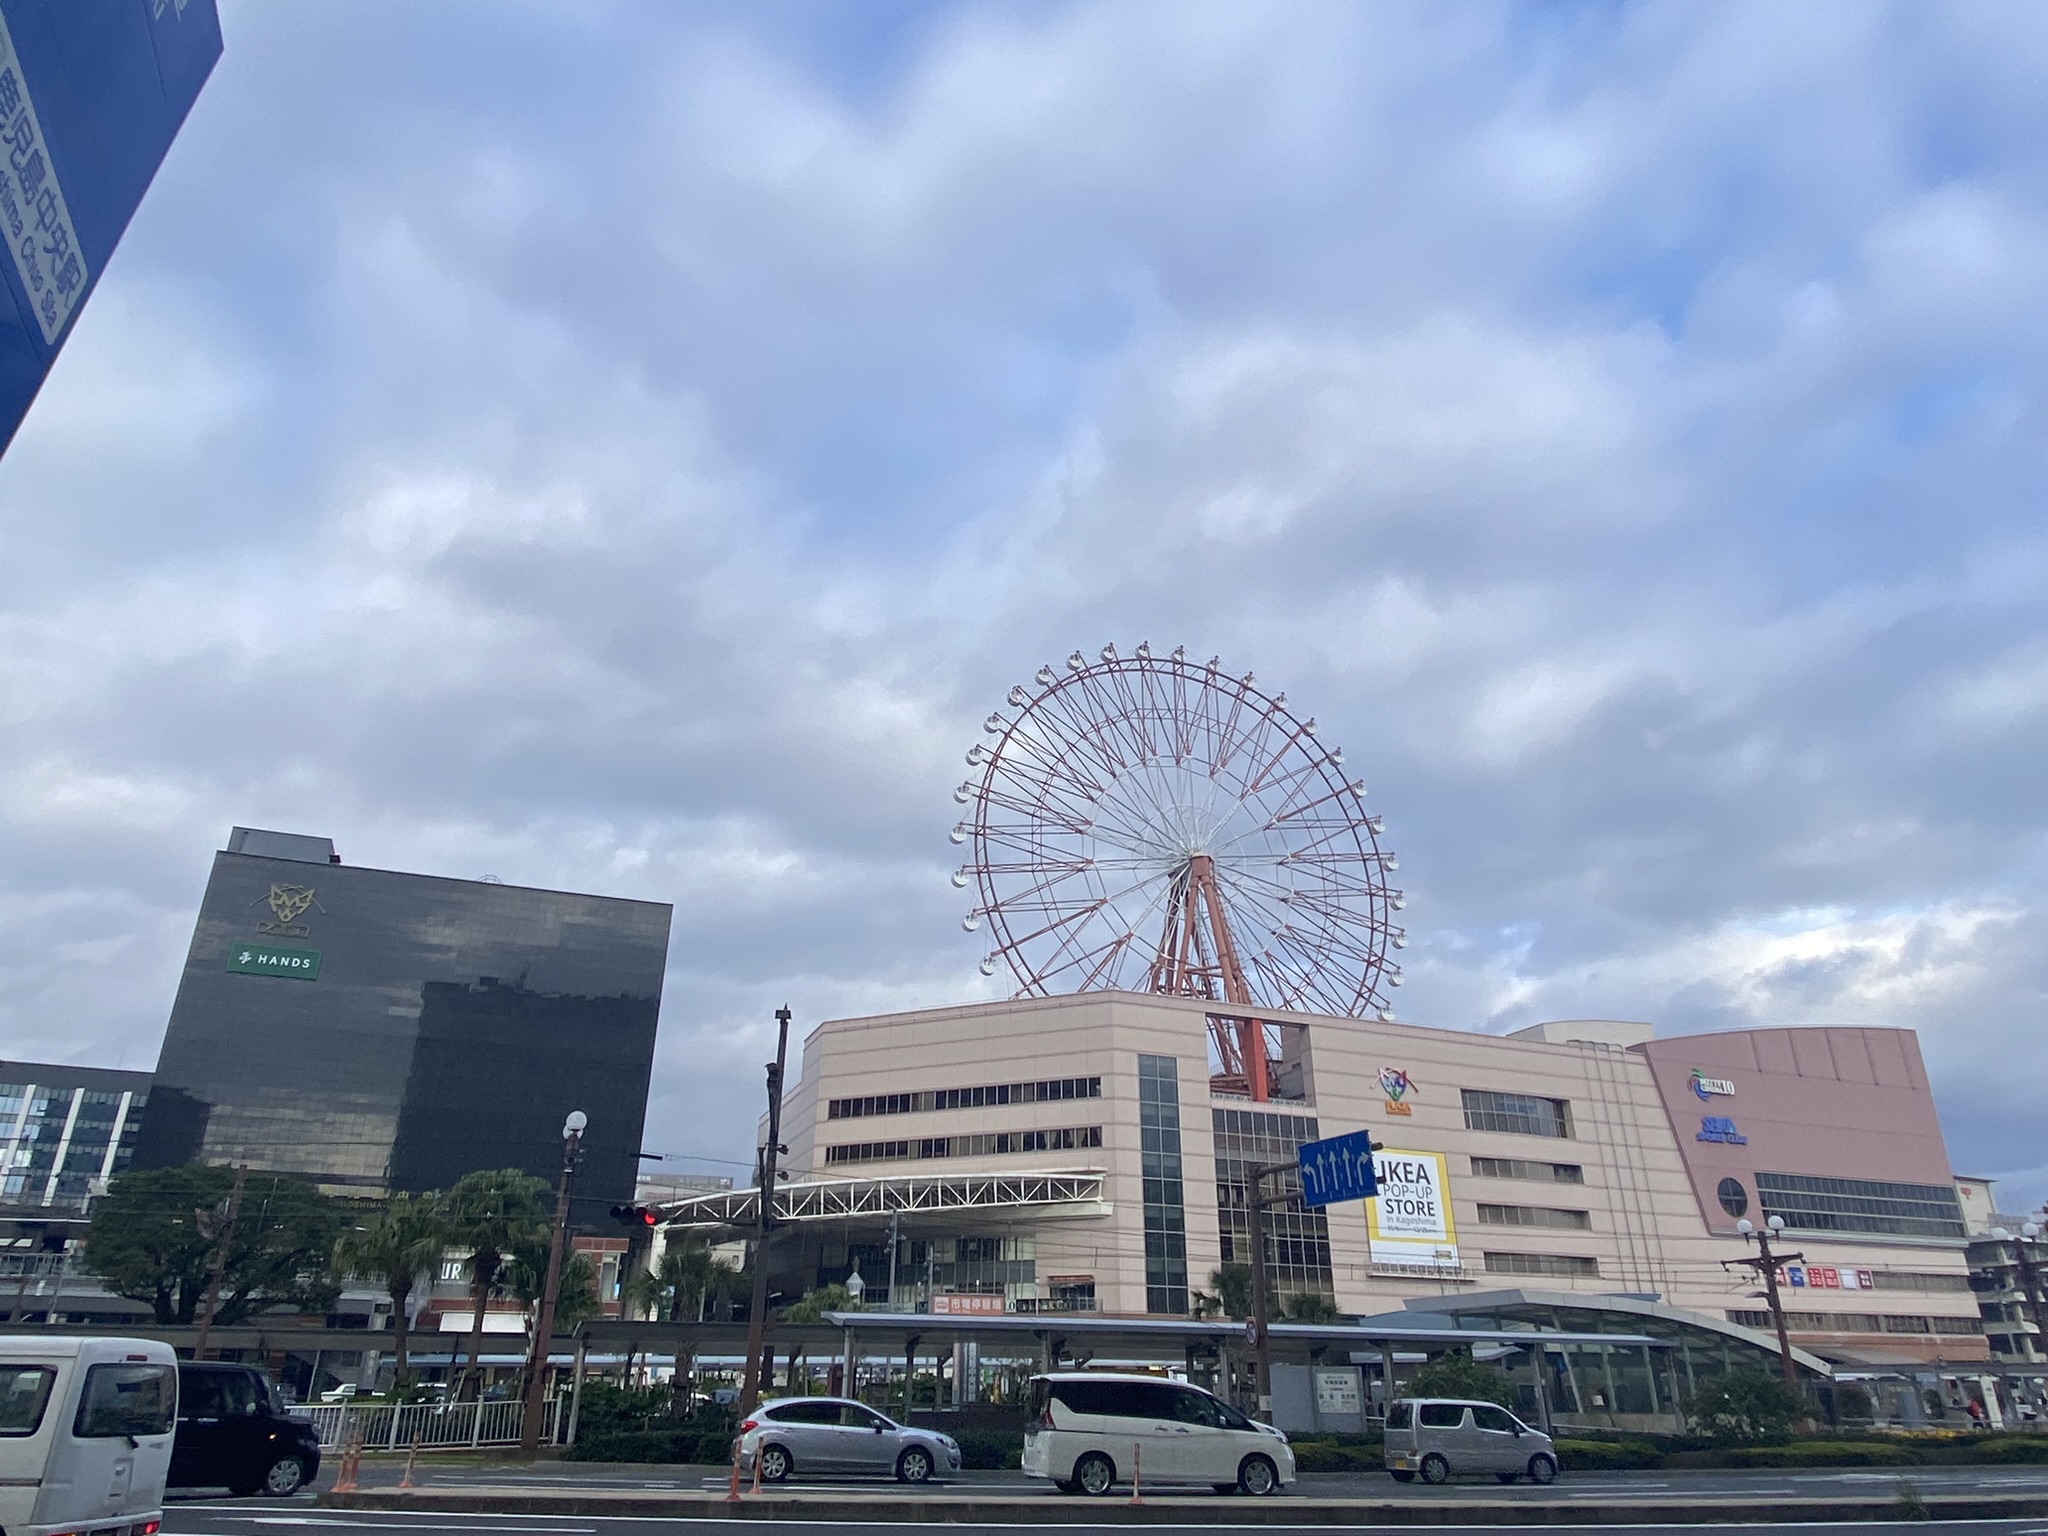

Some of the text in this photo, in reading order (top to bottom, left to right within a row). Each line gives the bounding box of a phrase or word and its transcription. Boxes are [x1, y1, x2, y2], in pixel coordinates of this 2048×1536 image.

[258, 955, 310, 968] HANDS
[1381, 1160, 1431, 1185] IKEA
[1383, 1184, 1433, 1199] POP-UP
[1385, 1198, 1436, 1217] STORE
[1396, 1216, 1437, 1227] Kagoshima
